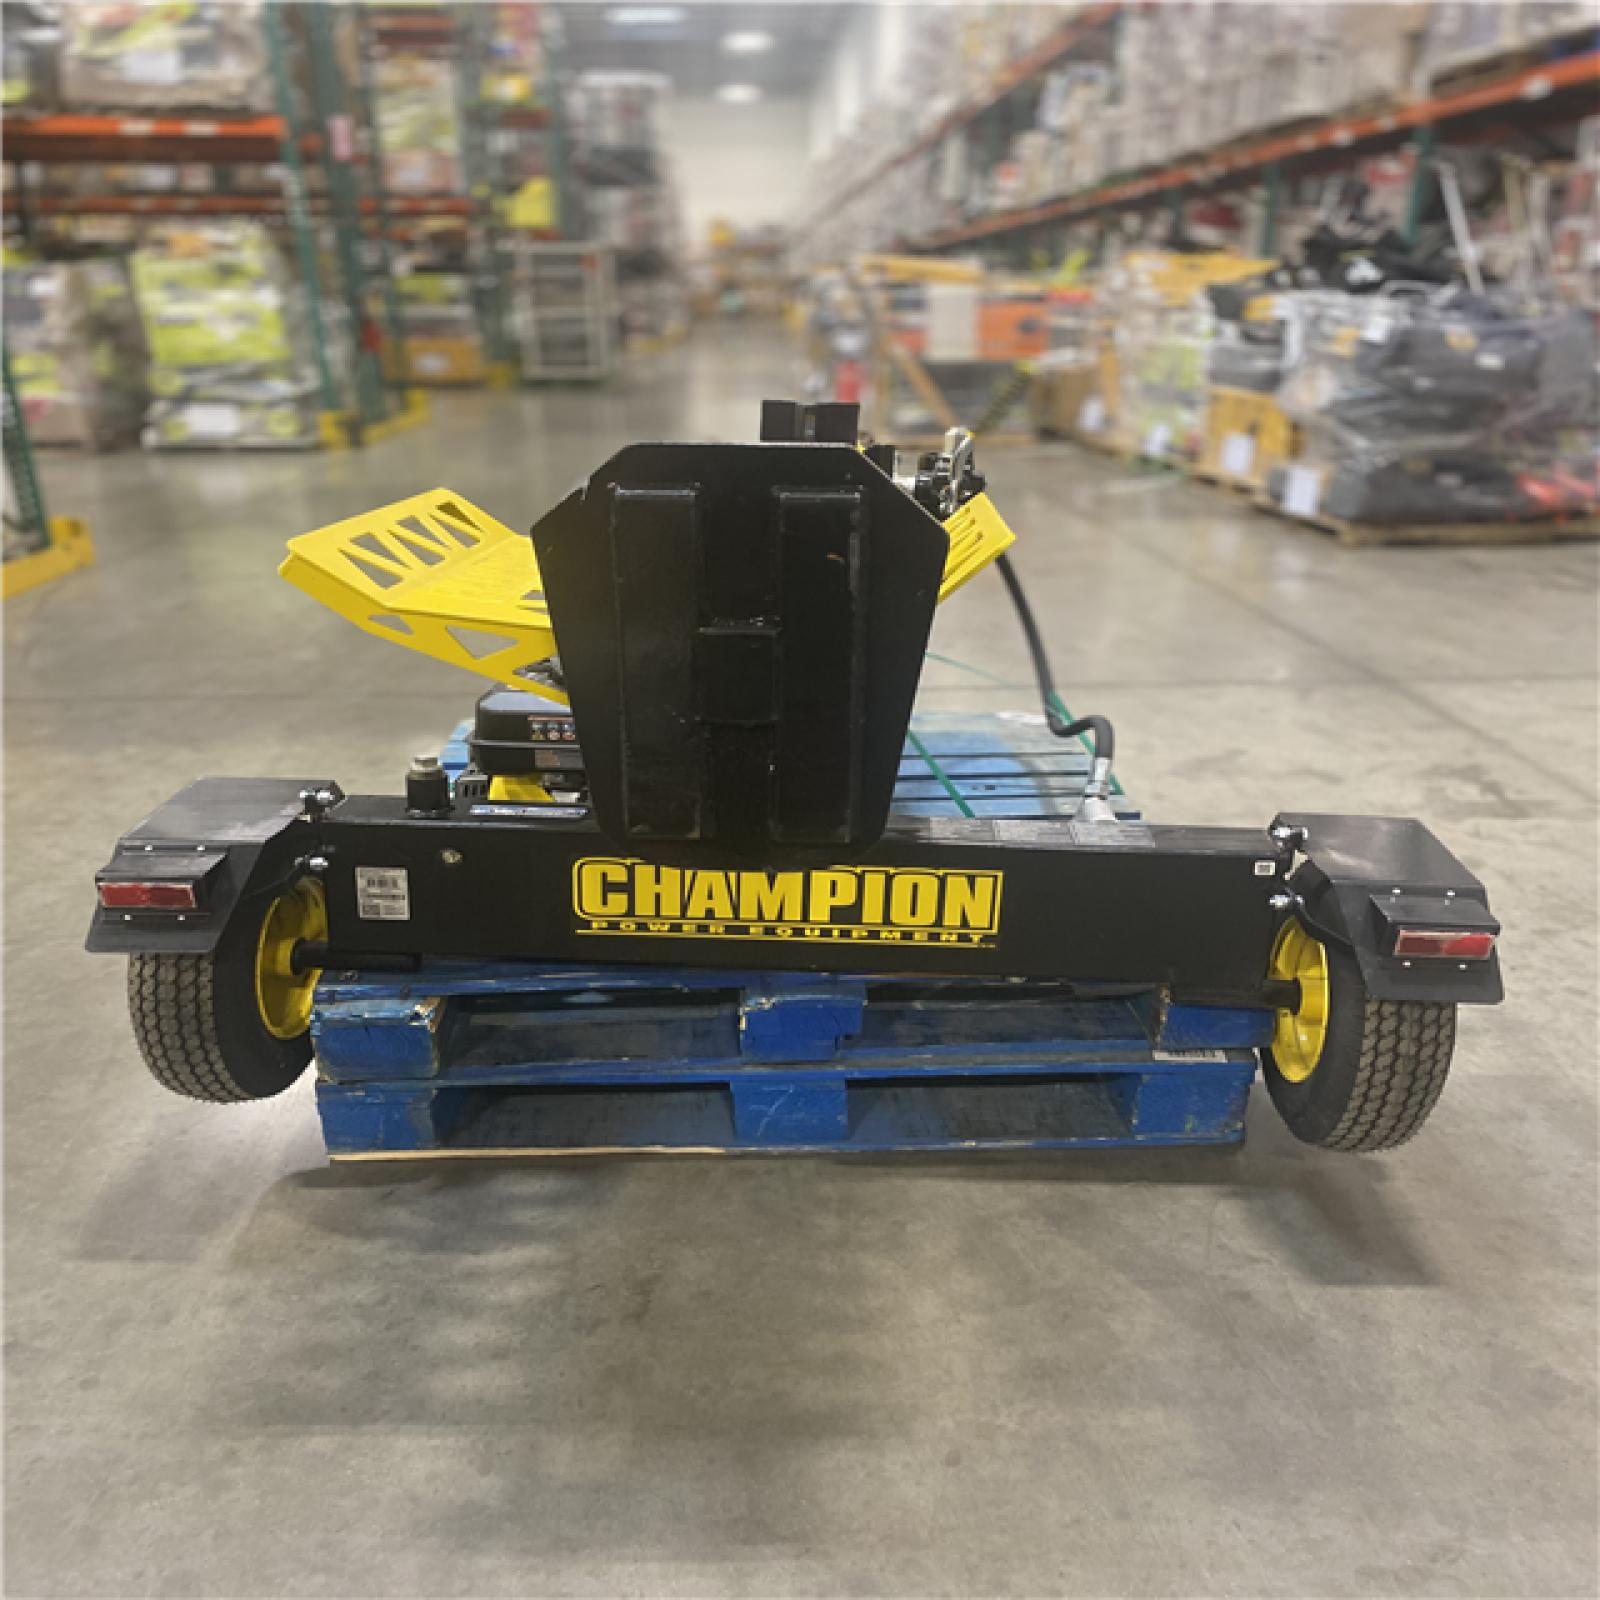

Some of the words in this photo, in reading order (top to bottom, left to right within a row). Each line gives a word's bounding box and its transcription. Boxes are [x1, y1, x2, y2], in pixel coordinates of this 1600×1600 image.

[580, 862, 995, 929] CHAMPION
[591, 920, 725, 935] POWER
[749, 924, 983, 943] EQUIPMENT
